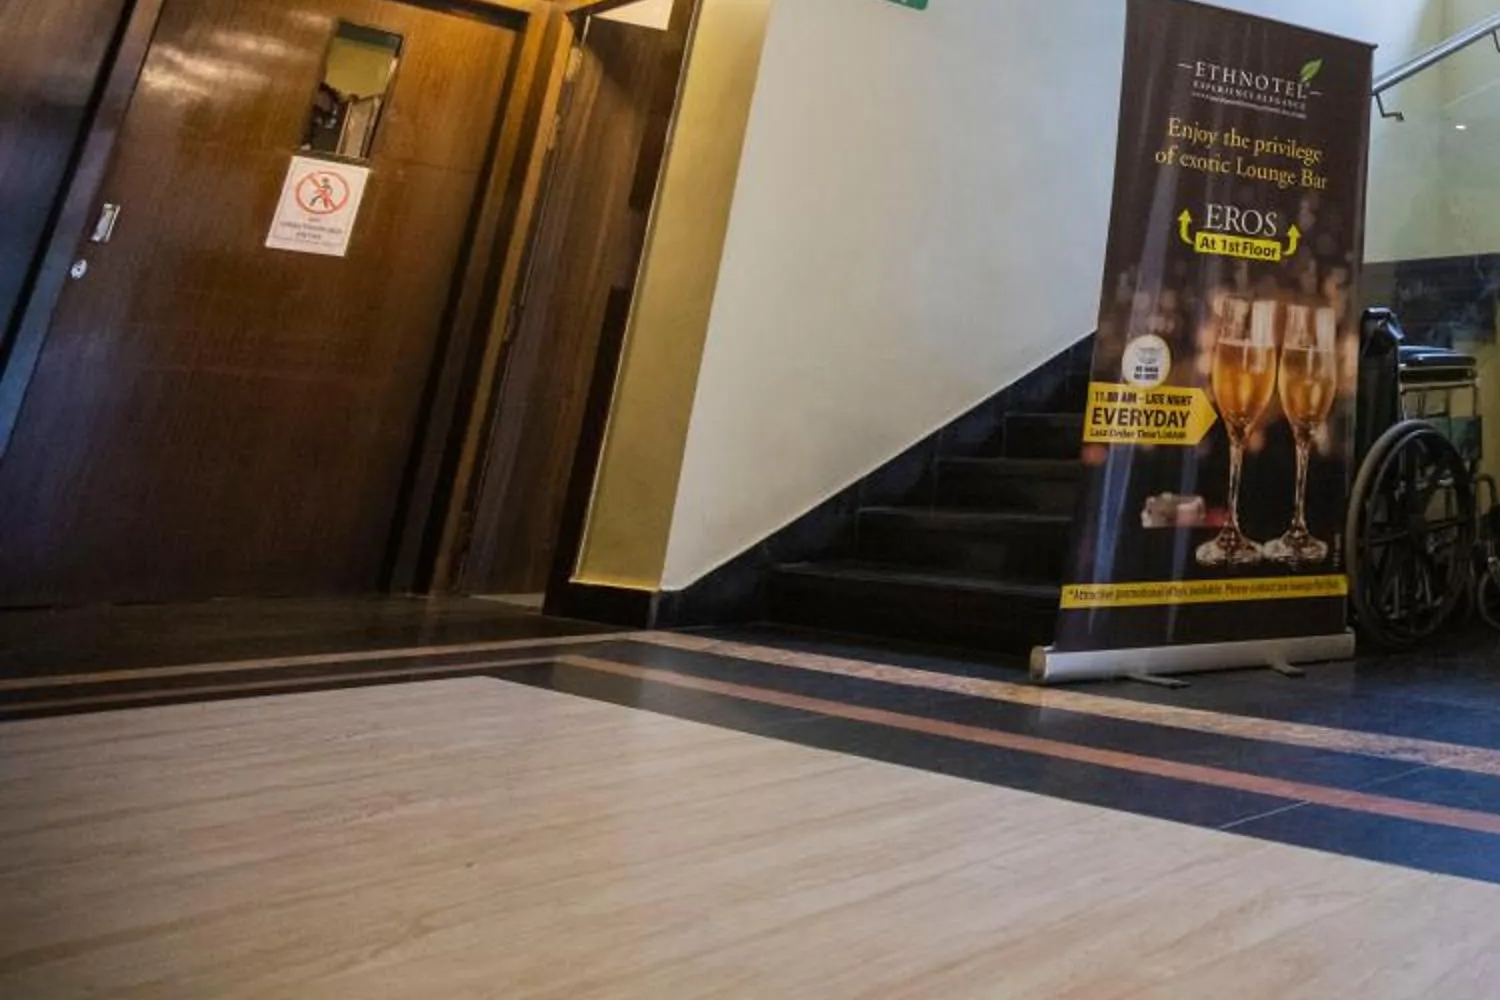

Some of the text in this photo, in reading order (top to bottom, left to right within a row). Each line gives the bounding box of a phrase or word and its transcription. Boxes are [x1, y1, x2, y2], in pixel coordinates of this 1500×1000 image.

[1196, 61, 1307, 99] ETHNOTEL
[1168, 117, 1323, 166] Enjoy the privilege
[1155, 145, 1327, 190] of exotic Lounge Bar
[1204, 203, 1277, 237] EROS
[1200, 236, 1277, 258] At 1st Floor
[1091, 407, 1190, 428] EVERYDAY
